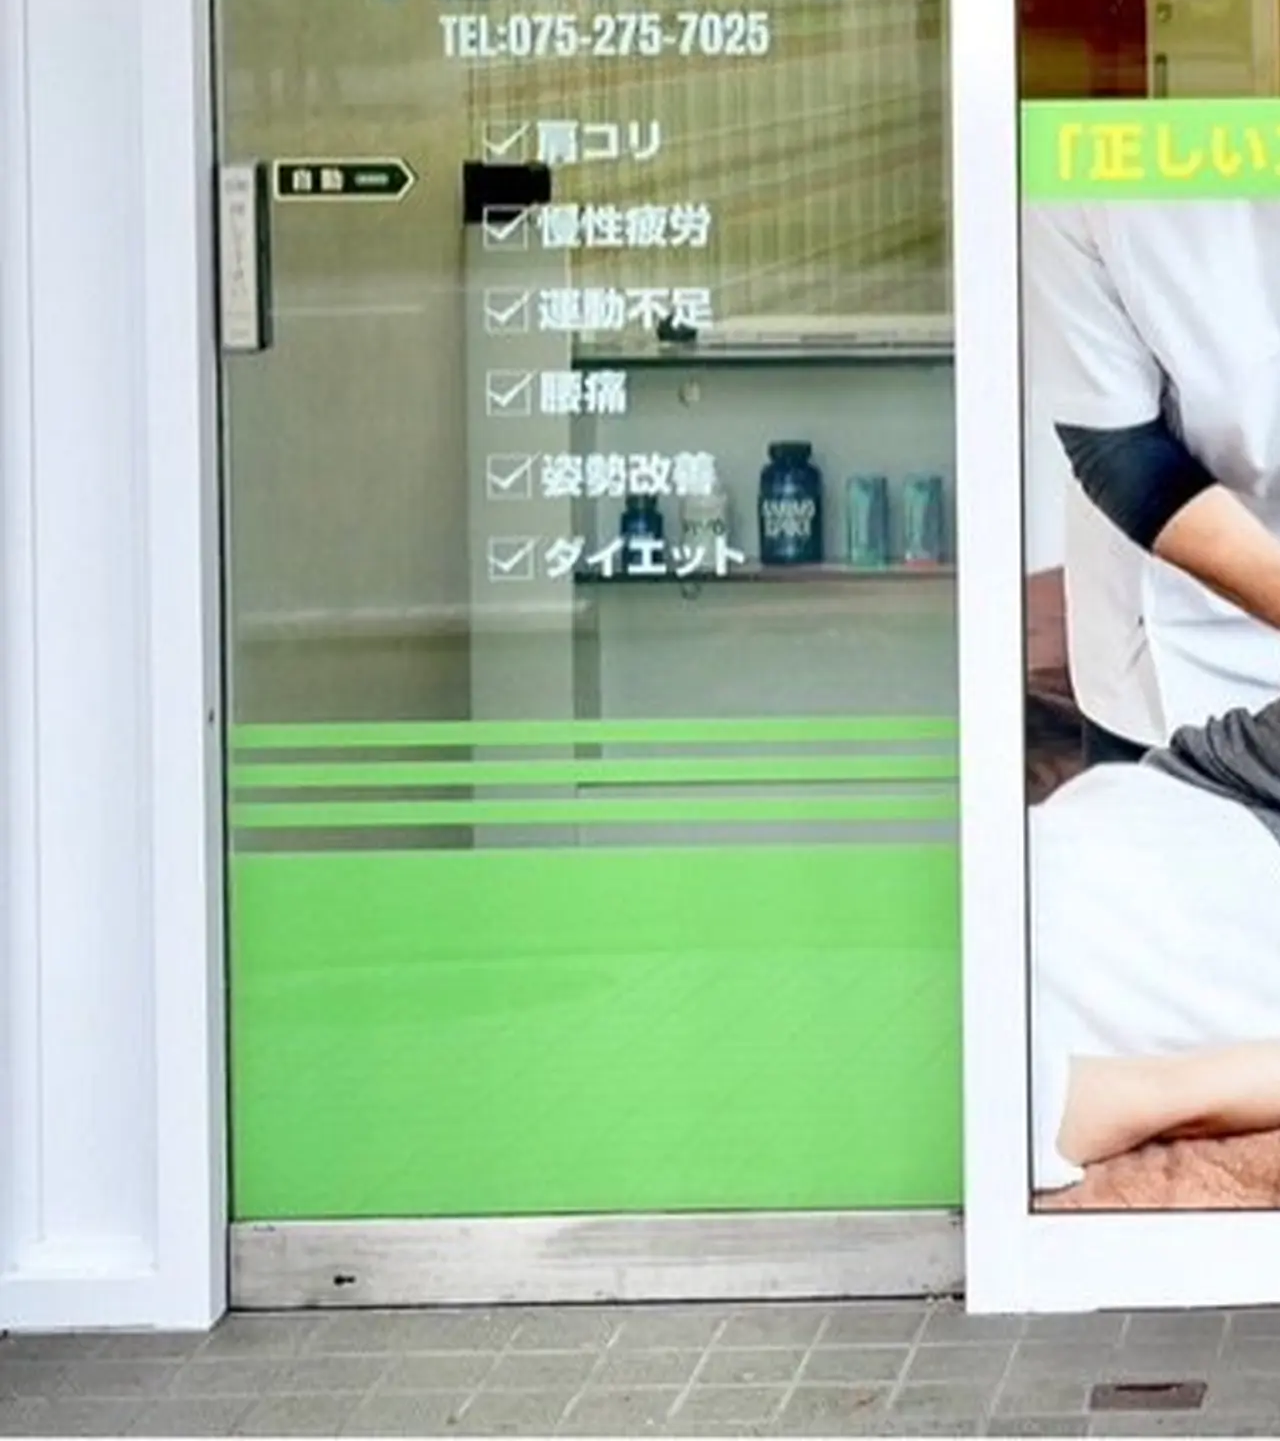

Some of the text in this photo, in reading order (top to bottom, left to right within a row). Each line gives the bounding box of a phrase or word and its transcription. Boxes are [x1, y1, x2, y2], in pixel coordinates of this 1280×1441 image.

[439, 13, 770, 57] TEL:075-275-7025
[538, 288, 713, 330] 運動不足
[541, 452, 716, 497] 姿勢改善
[545, 536, 745, 577] ダイエット
